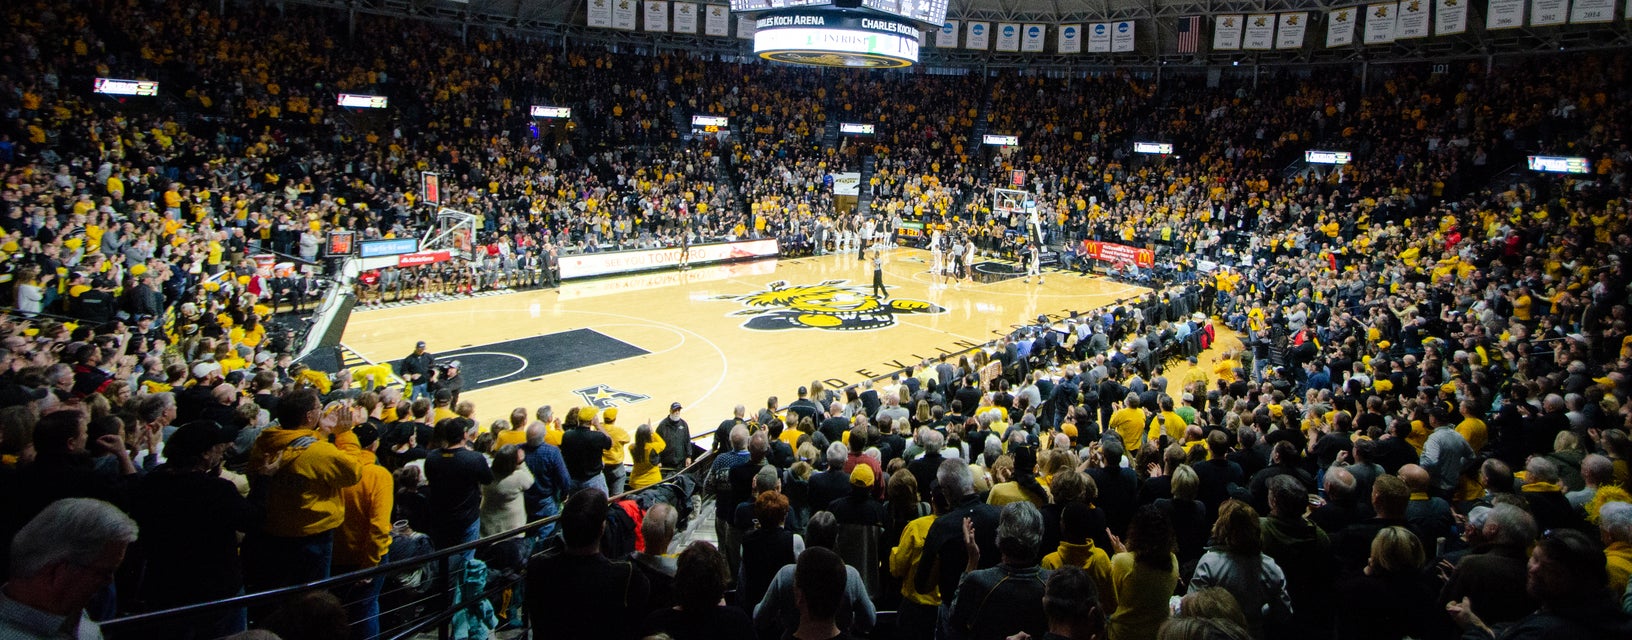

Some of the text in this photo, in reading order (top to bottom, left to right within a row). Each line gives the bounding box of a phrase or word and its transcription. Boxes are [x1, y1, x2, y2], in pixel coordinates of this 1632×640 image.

[774, 15, 793, 26] KOCH
[794, 15, 825, 25] ARENA
[861, 18, 897, 32] CHARLES
[897, 24, 912, 35] KOCH
[1432, 64, 1449, 73] 101
[624, 256, 646, 265] YOU
[835, 313, 890, 322] WSU
